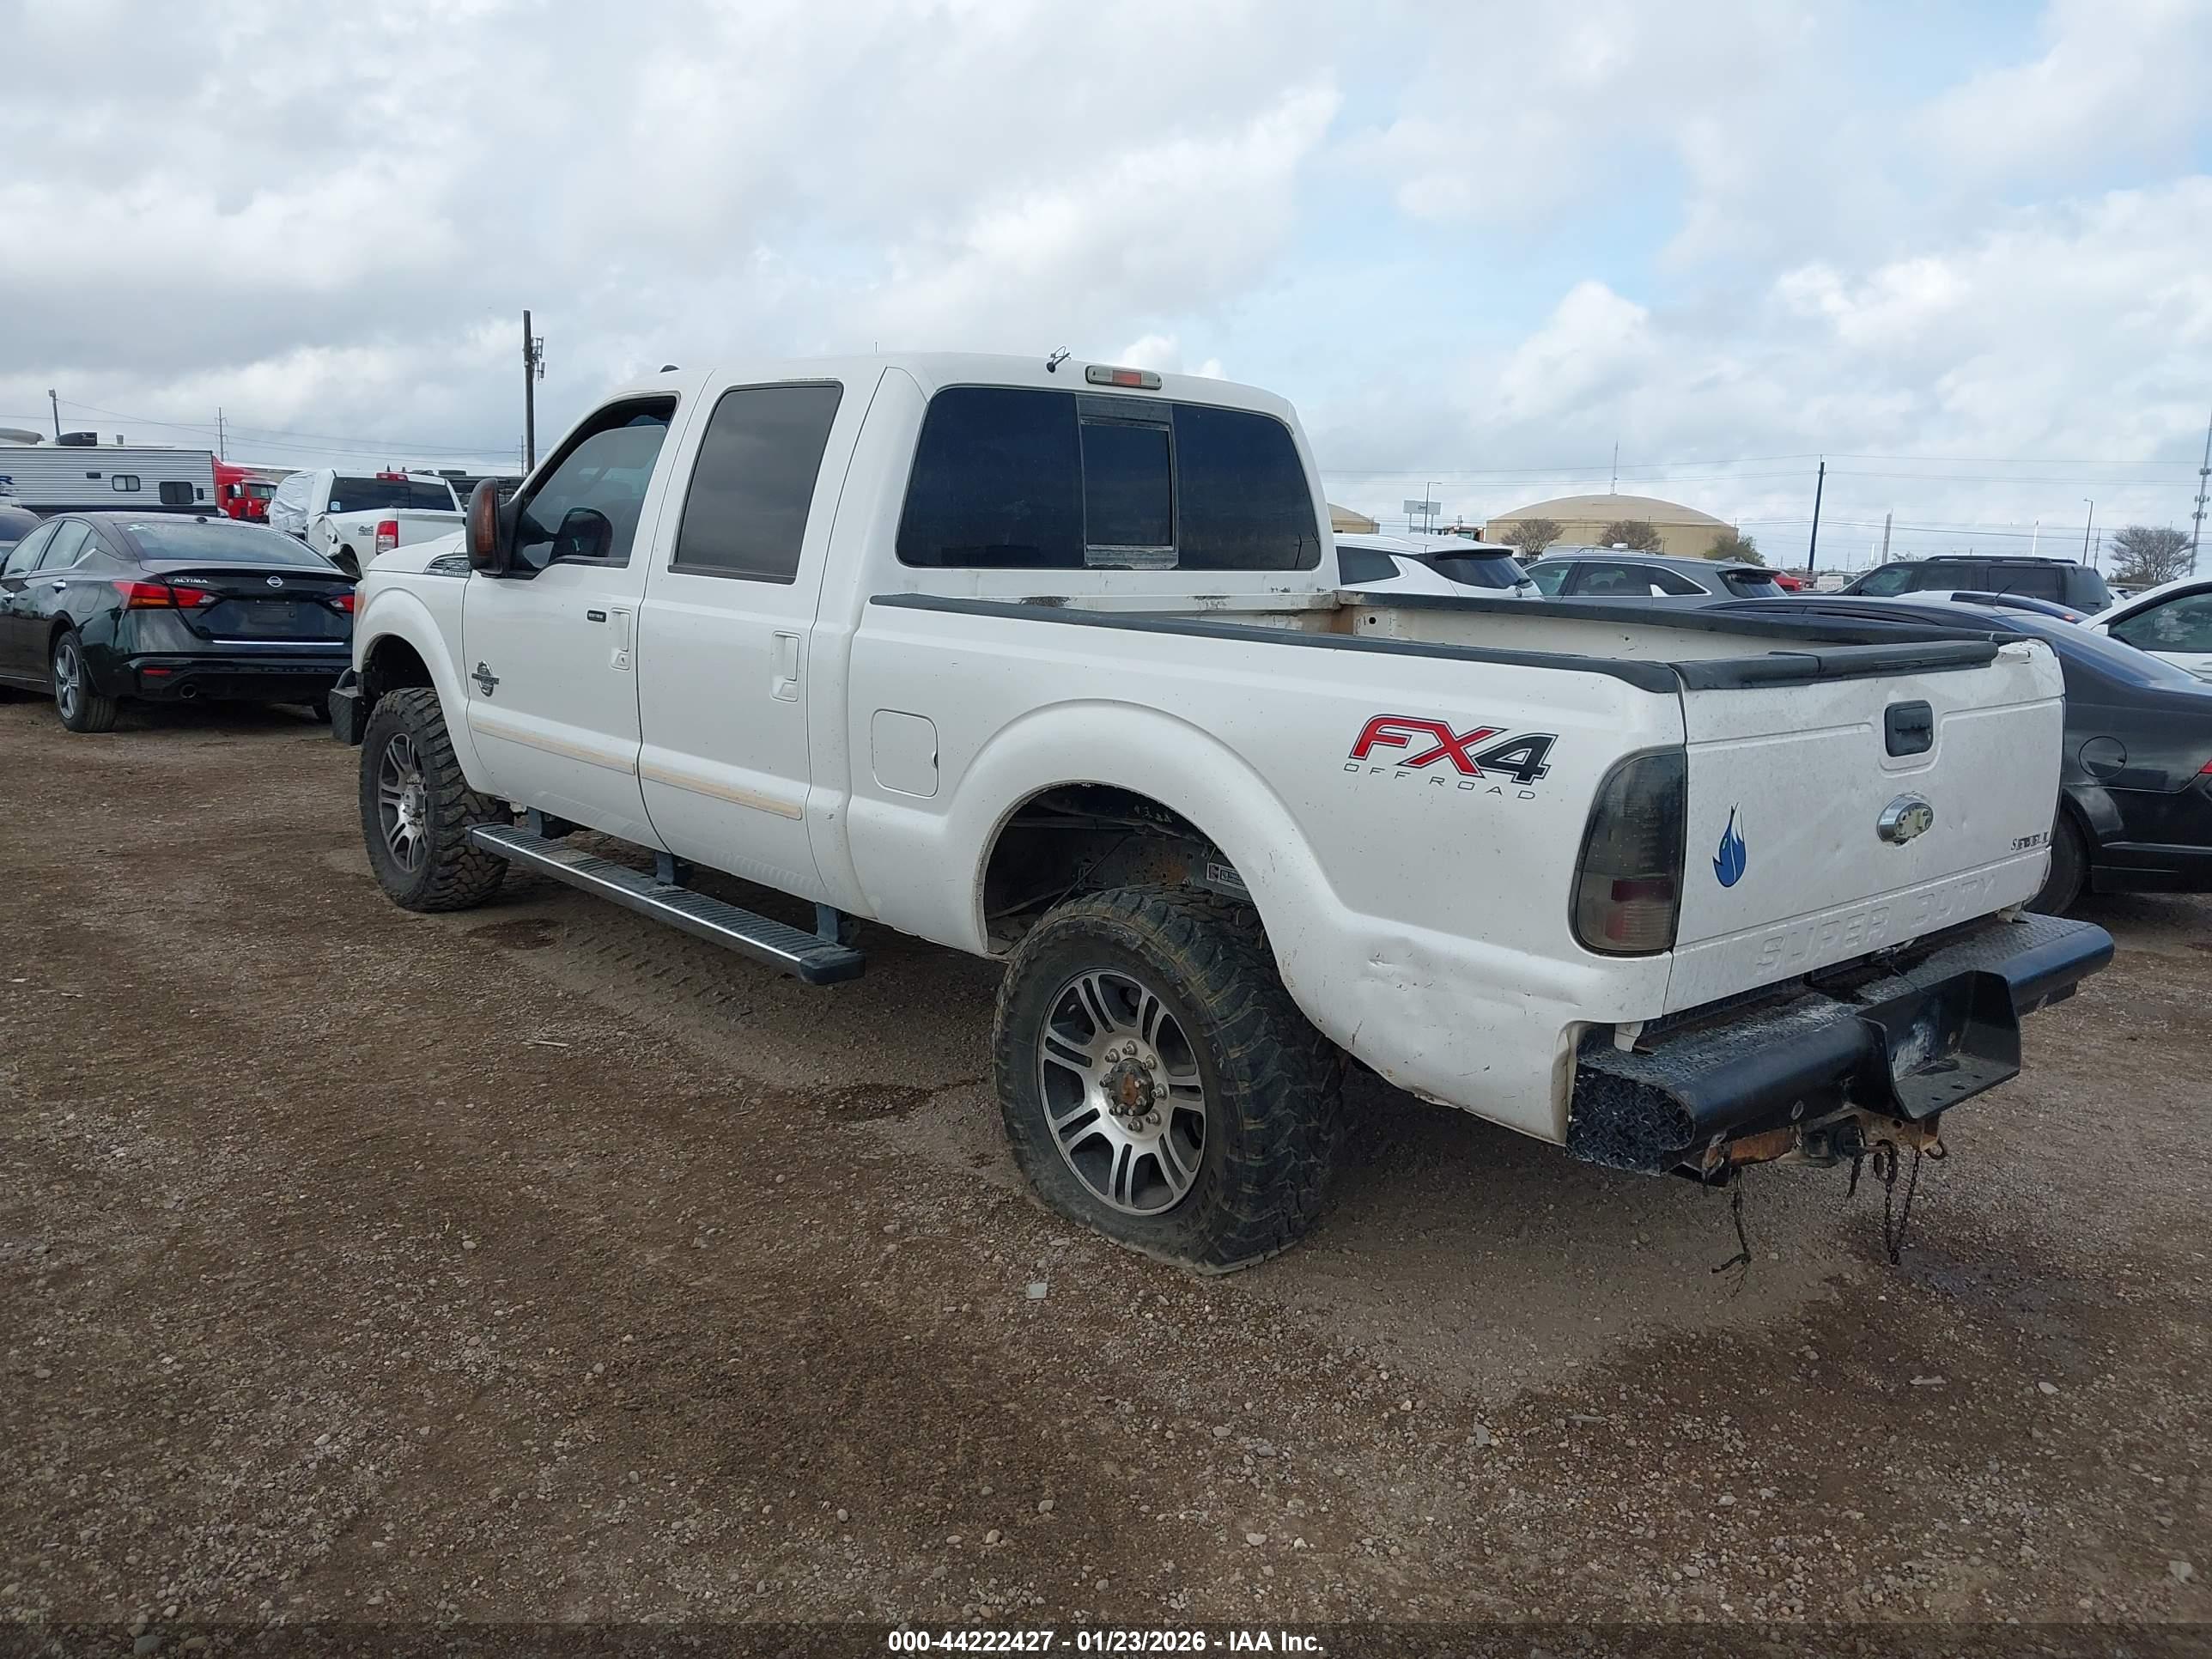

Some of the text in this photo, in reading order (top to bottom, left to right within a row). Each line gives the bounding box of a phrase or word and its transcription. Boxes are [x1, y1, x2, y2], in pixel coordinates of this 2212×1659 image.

[1348, 714, 1559, 786] FX4
[1756, 874, 1996, 969] SUPER DUTY
